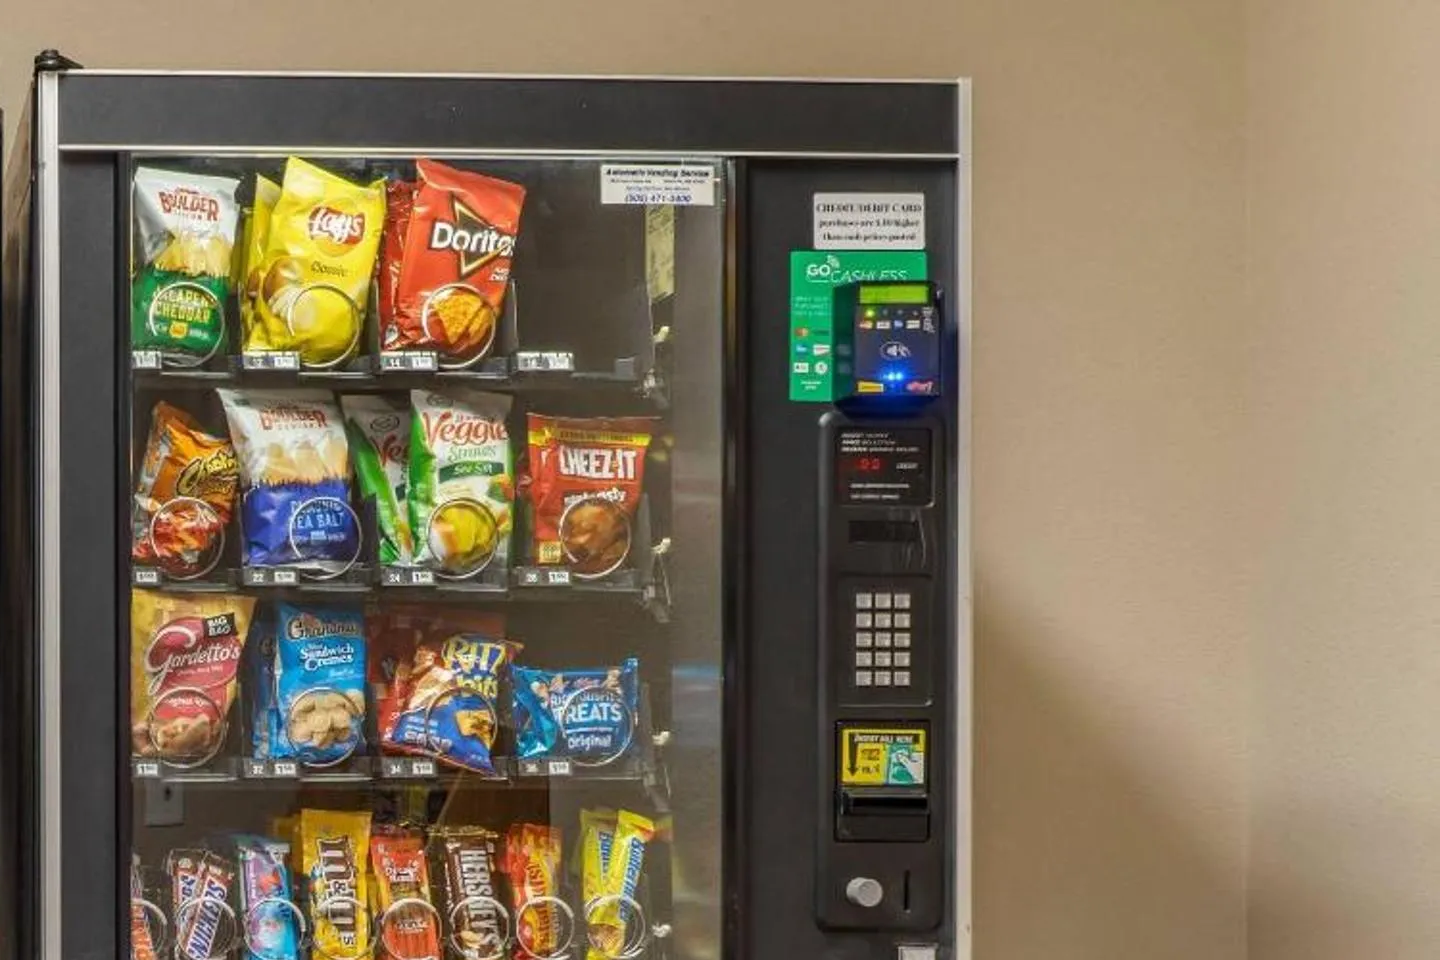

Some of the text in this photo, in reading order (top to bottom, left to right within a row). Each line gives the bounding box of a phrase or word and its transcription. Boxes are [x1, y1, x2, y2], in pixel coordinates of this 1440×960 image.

[806, 264, 831, 277] GO
[422, 411, 511, 449] Veggie
[144, 625, 242, 697] Gardetto's
